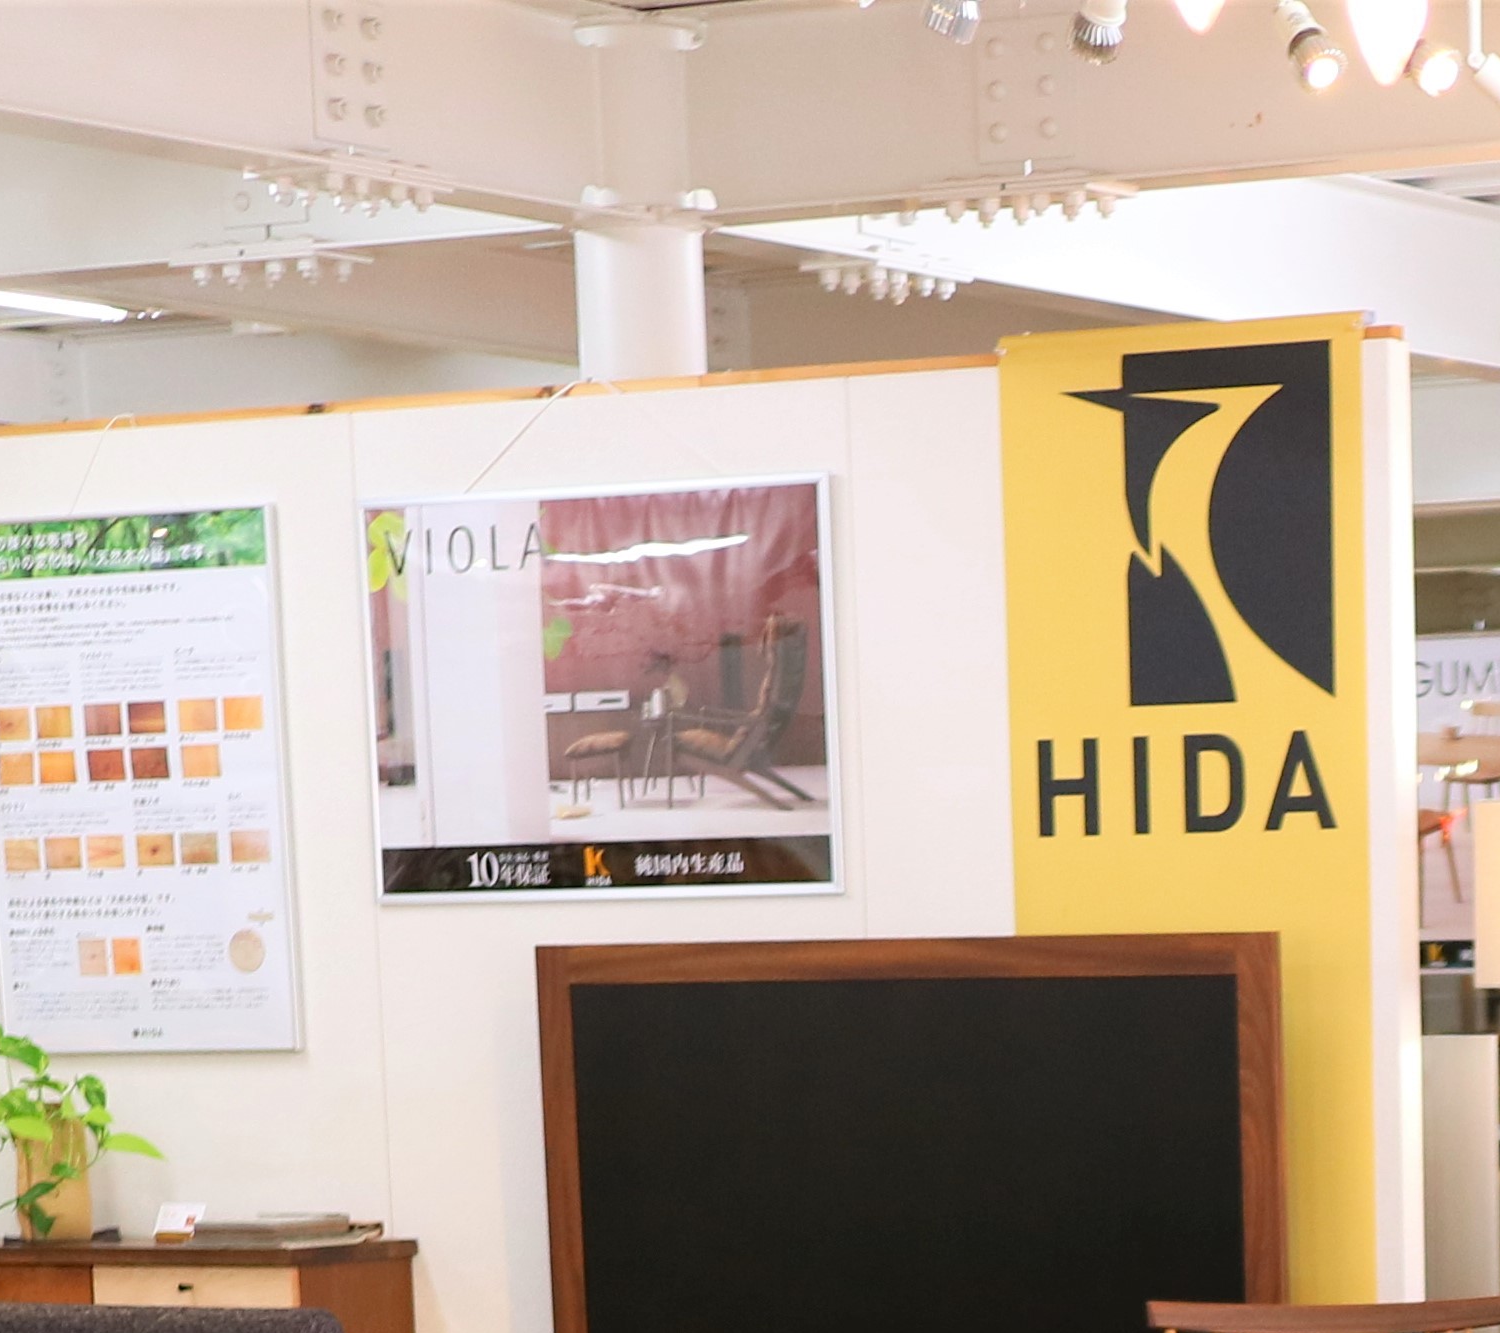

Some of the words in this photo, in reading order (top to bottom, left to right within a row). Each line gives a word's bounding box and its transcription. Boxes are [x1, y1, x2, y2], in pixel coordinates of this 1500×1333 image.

[383, 522, 549, 577] VIOLA
[1037, 729, 1338, 837] HIDA
[466, 850, 552, 888] 10年保証
[633, 851, 746, 877] 純国内生産品
